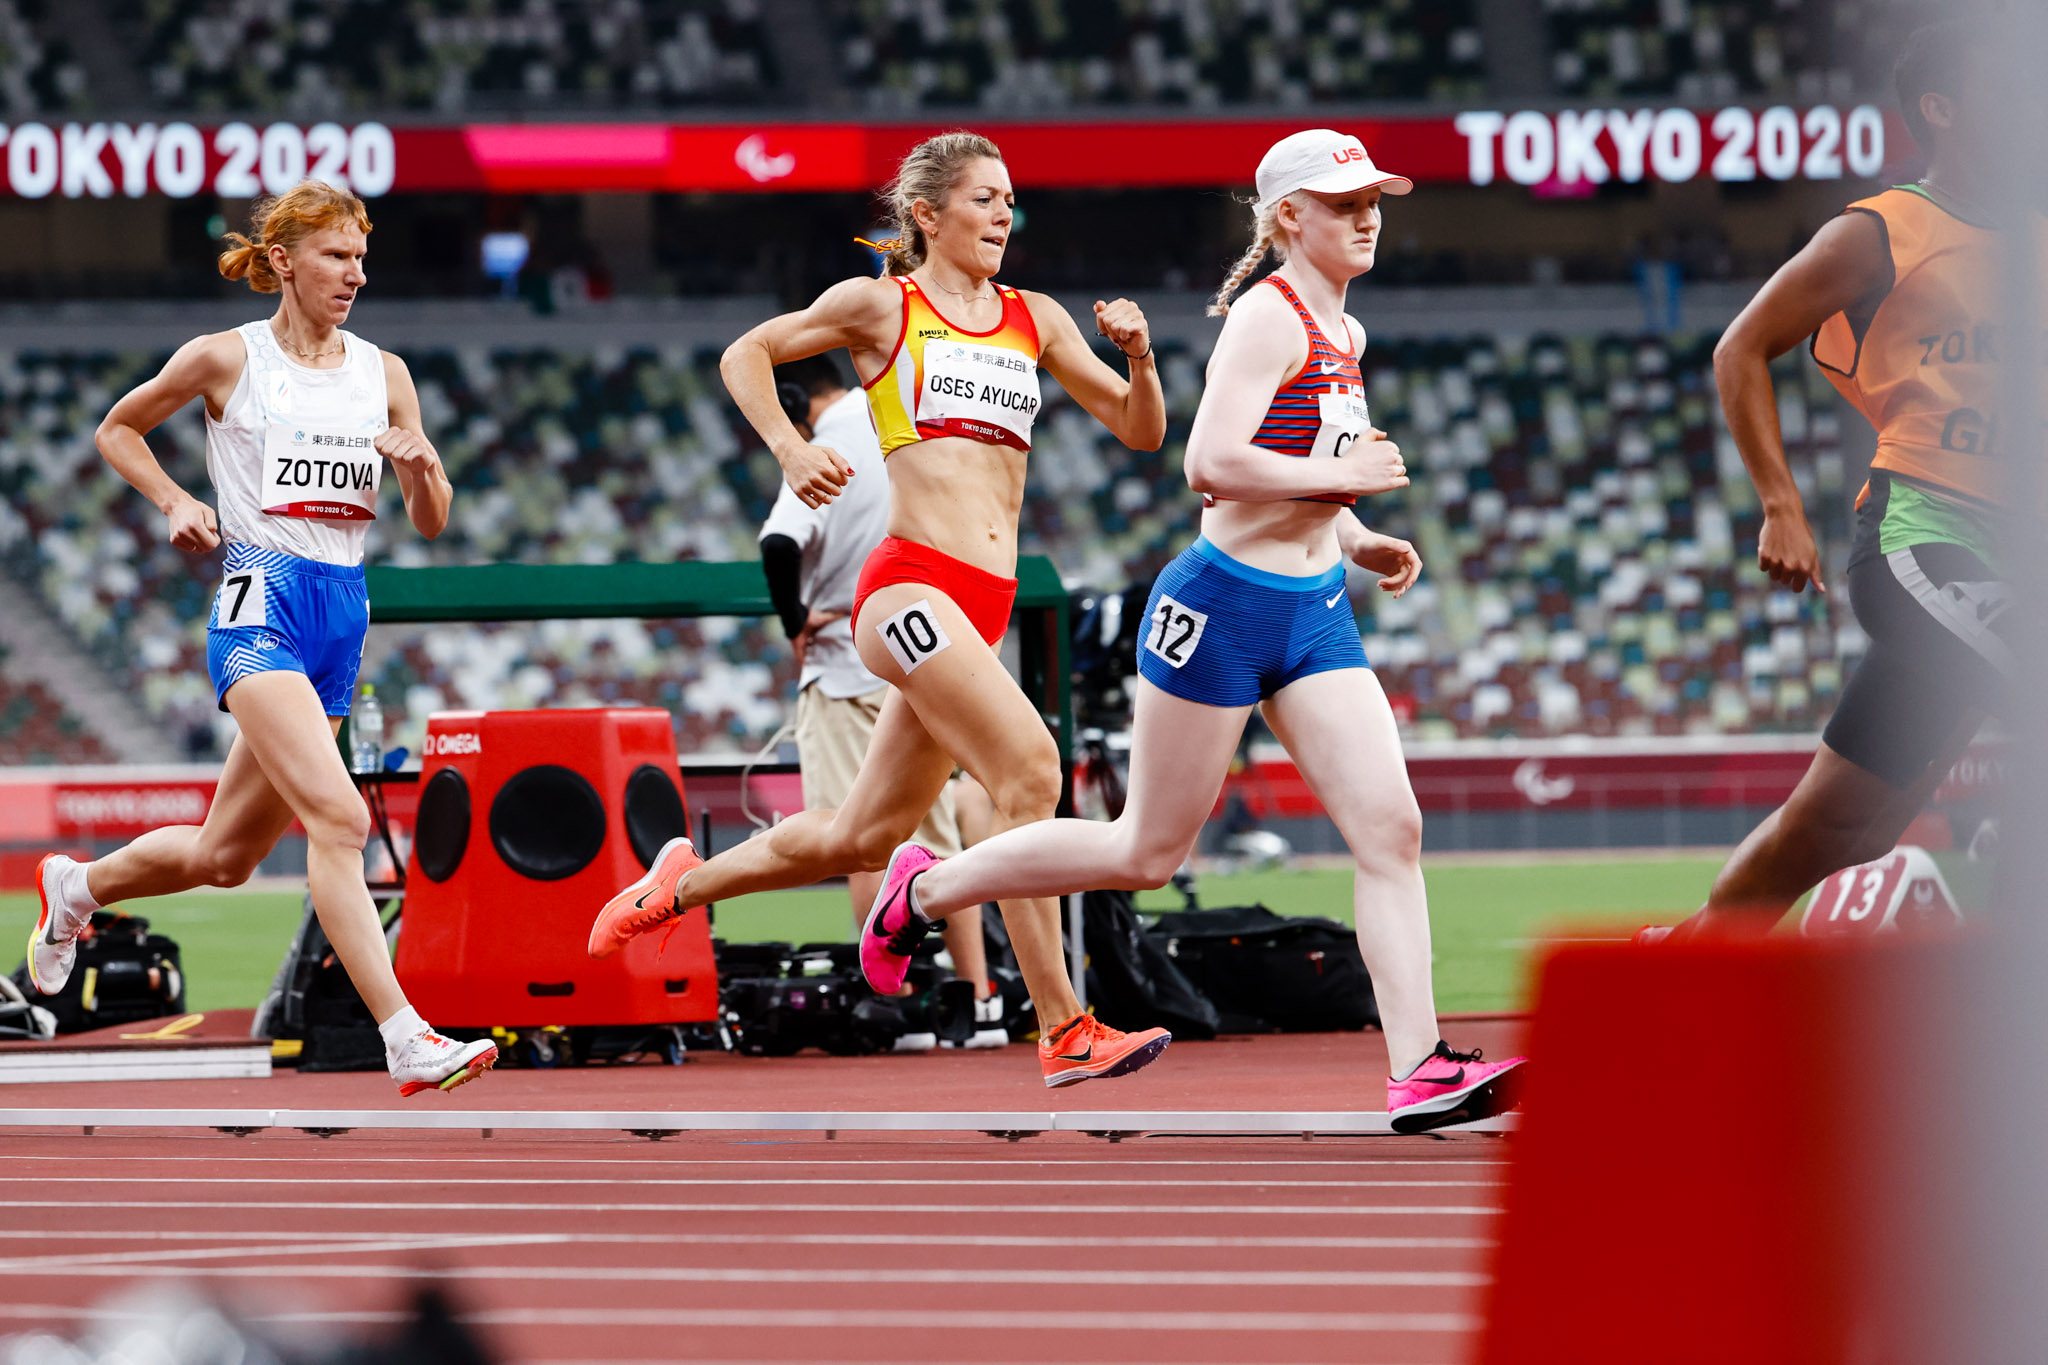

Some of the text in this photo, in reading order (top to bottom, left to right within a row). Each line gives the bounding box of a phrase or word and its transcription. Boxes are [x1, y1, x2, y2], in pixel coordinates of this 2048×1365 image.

[0, 122, 395, 198] OKYO 2020
[1454, 105, 1885, 186] TOKYO 2020
[918, 329, 949, 338] AMURA
[930, 375, 1038, 415] OSES AYUCAR
[961, 422, 994, 436] TOKYO 2020
[276, 458, 373, 491] ZOTOVA
[304, 505, 340, 513] TOKYO 2020
[226, 575, 252, 623] 7
[886, 610, 938, 664] 10
[1156, 604, 1195, 663] 12
[437, 733, 482, 755] OMEGA
[1828, 868, 1885, 922] 13
